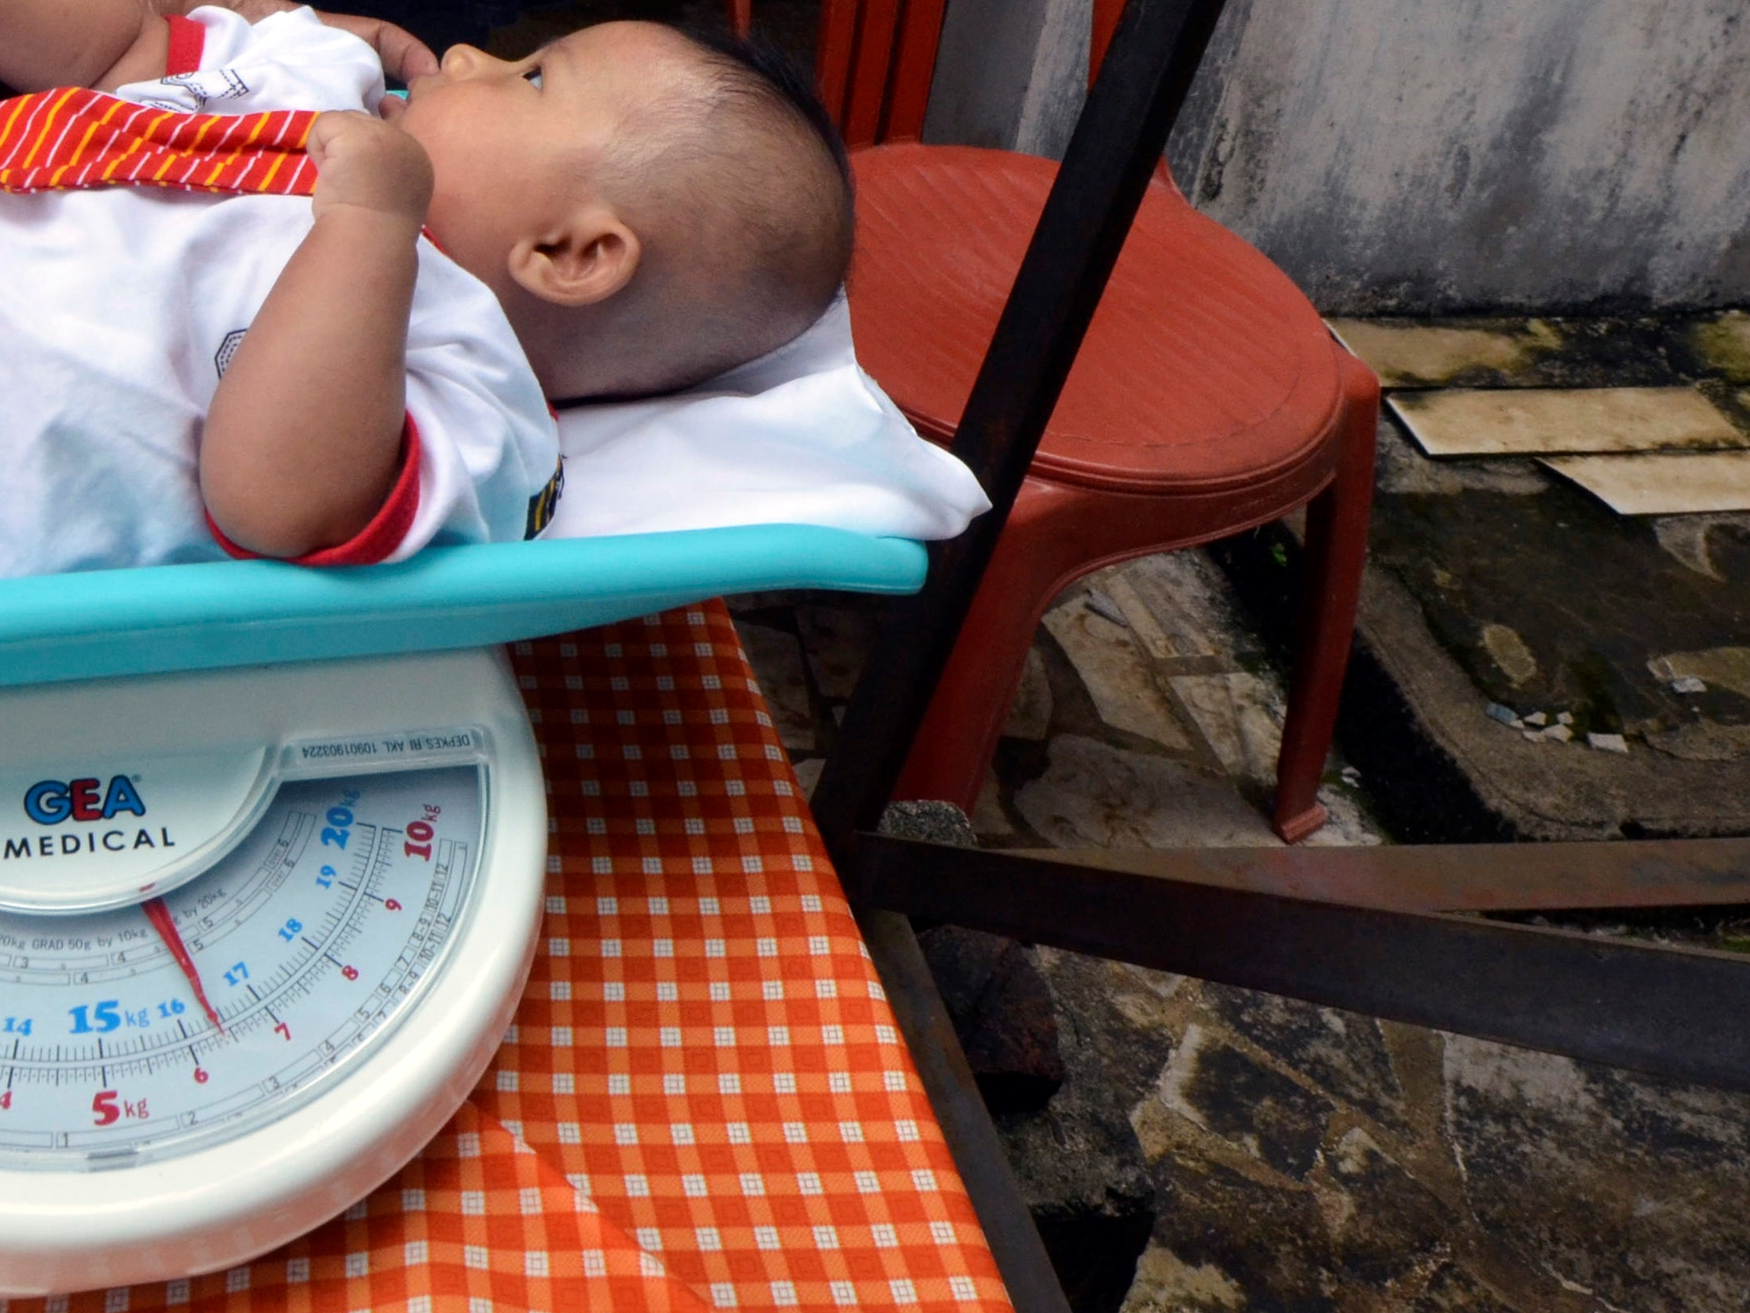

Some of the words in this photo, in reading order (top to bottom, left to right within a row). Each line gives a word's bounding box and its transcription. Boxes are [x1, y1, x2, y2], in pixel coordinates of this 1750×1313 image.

[24, 774, 147, 826] GEA
[3, 827, 175, 859] MEDICAL
[2, 1016, 34, 1037] 14
[156, 998, 187, 1019] 16
[223, 960, 251, 987] 17
[278, 917, 304, 943] 18
[316, 864, 338, 890] 19
[21, 957, 29, 969] 3
[117, 952, 127, 963] 4
[202, 917, 214, 928] 5
[32, 939, 64, 951] GRAD
[97, 937, 112, 948] by
[81, 972, 89, 984] 4
[193, 940, 204, 951] 5
[193, 1066, 210, 1085] 6
[274, 1022, 292, 1042] 7
[342, 965, 359, 981] 8
[384, 897, 403, 911] 9
[188, 1110, 199, 1125] 2
[357, 1006, 370, 1020] 5
